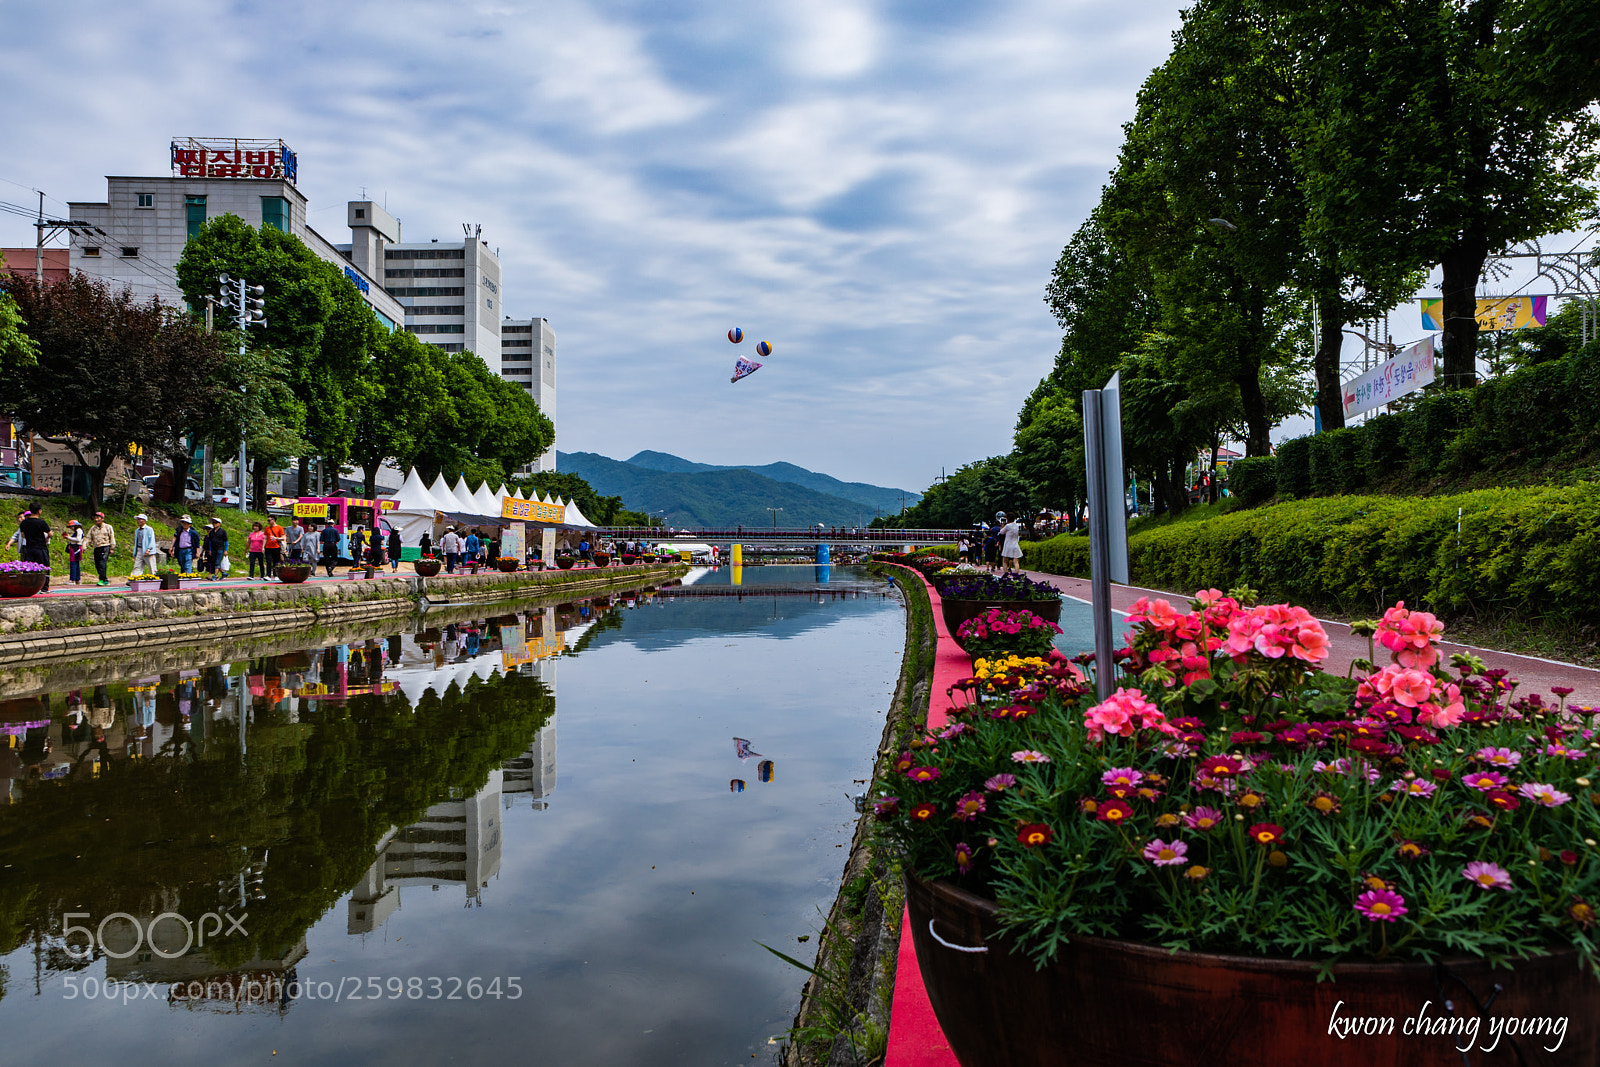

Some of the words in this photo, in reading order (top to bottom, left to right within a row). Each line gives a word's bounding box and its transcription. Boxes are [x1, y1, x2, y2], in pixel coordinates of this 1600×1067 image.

[174, 150, 281, 178] 찜질방
[297, 504, 325, 515] 타코야끼
[512, 501, 531, 517] 음성군
